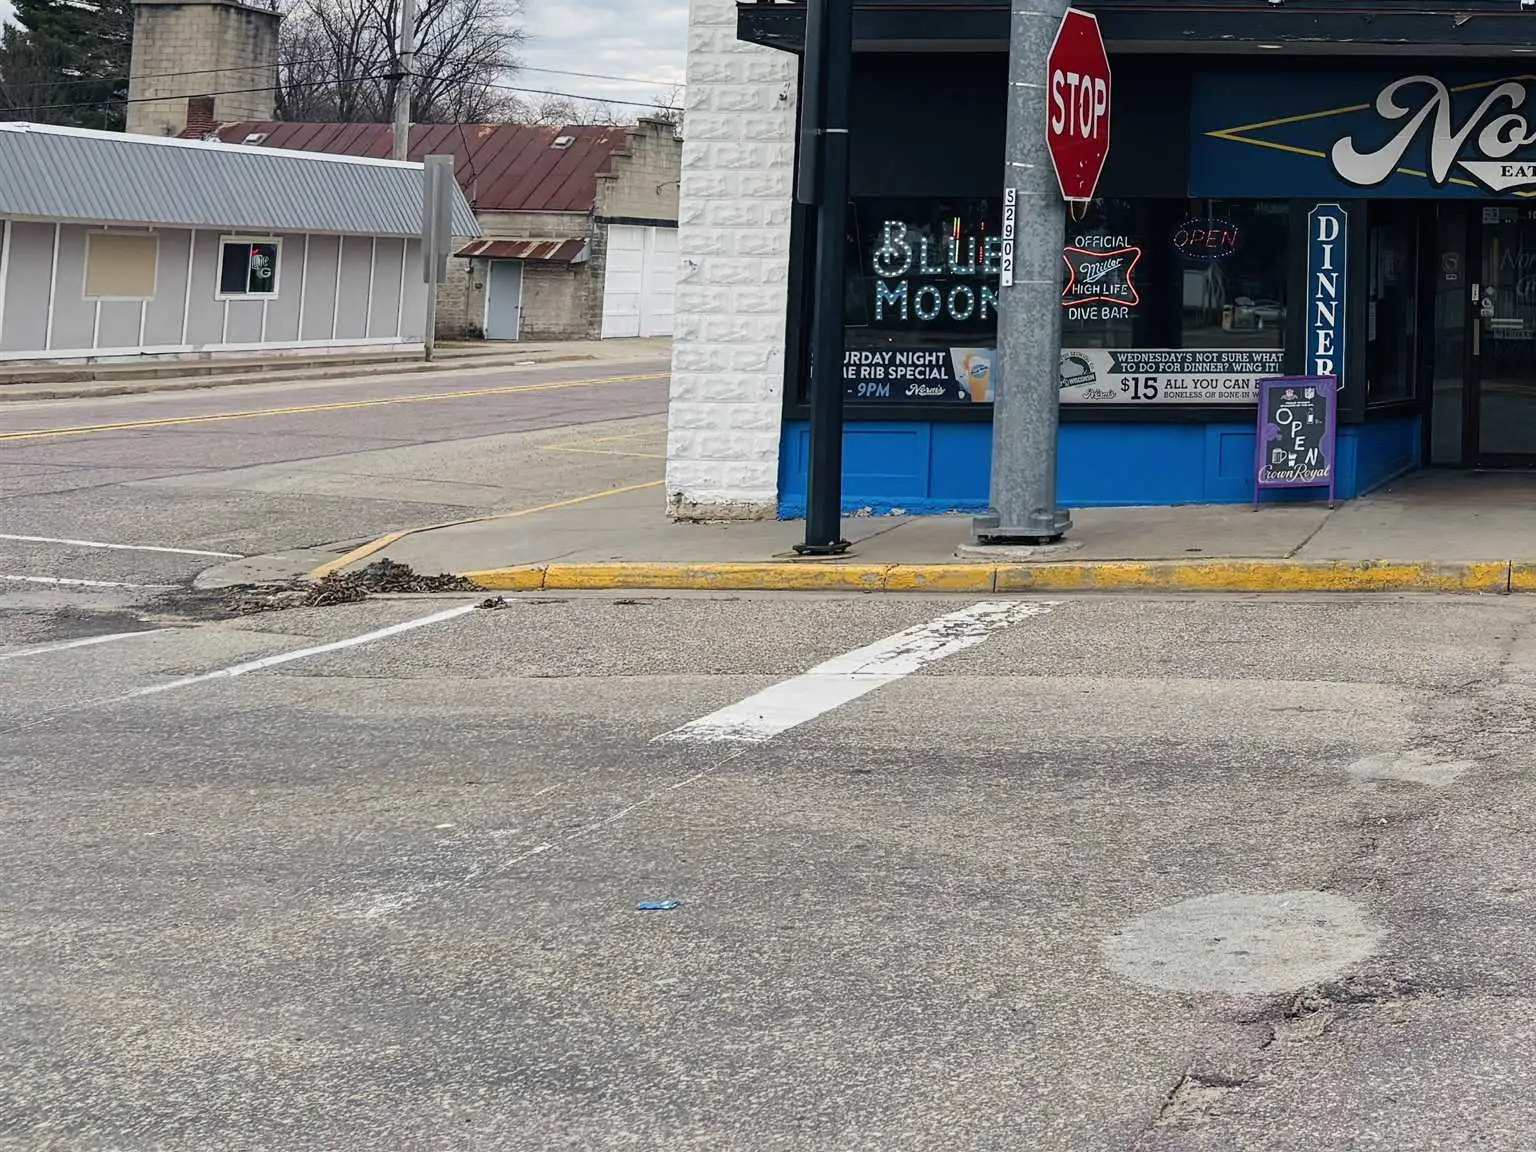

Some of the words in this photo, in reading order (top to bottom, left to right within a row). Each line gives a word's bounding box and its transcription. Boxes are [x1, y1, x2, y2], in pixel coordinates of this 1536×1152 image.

[1052, 69, 1107, 139] STOP
[1075, 235, 1131, 248] OFFICIAL
[1174, 230, 1238, 247] OPEN
[873, 220, 1001, 277] BLUE
[1079, 258, 1124, 283] Miller
[1072, 284, 1100, 295] HIGH
[1102, 284, 1128, 295] LIFE
[1315, 216, 1339, 375] DINNER
[1069, 307, 1097, 320] DIVE
[1101, 307, 1129, 320] BAR
[895, 351, 946, 365] NIGHT
[1117, 352, 1192, 362] WEDNESDAY'S
[1196, 353, 1219, 362] NOT
[1221, 353, 1249, 362] SURE
[1252, 353, 1283, 362] WHAT
[860, 366, 885, 379] RIB
[888, 366, 949, 380] SPECIAL
[1121, 362, 1138, 372] TO
[1139, 362, 1156, 372] DO
[1158, 362, 1181, 372] FOR
[1184, 362, 1229, 373] DINNER?
[1232, 362, 1262, 373] WING
[857, 382, 890, 397] 9PM
[1121, 376, 1158, 400] $15
[1164, 379, 1188, 390] ALL
[1191, 379, 1220, 390] YOU
[1223, 379, 1251, 390] CAN
[1164, 391, 1203, 399] BONELESS
[1218, 391, 1250, 399] BONE-IN
[1276, 408, 1318, 466] OPEN
[1258, 464, 1297, 483] Crown
[1293, 463, 1331, 483] Royal
